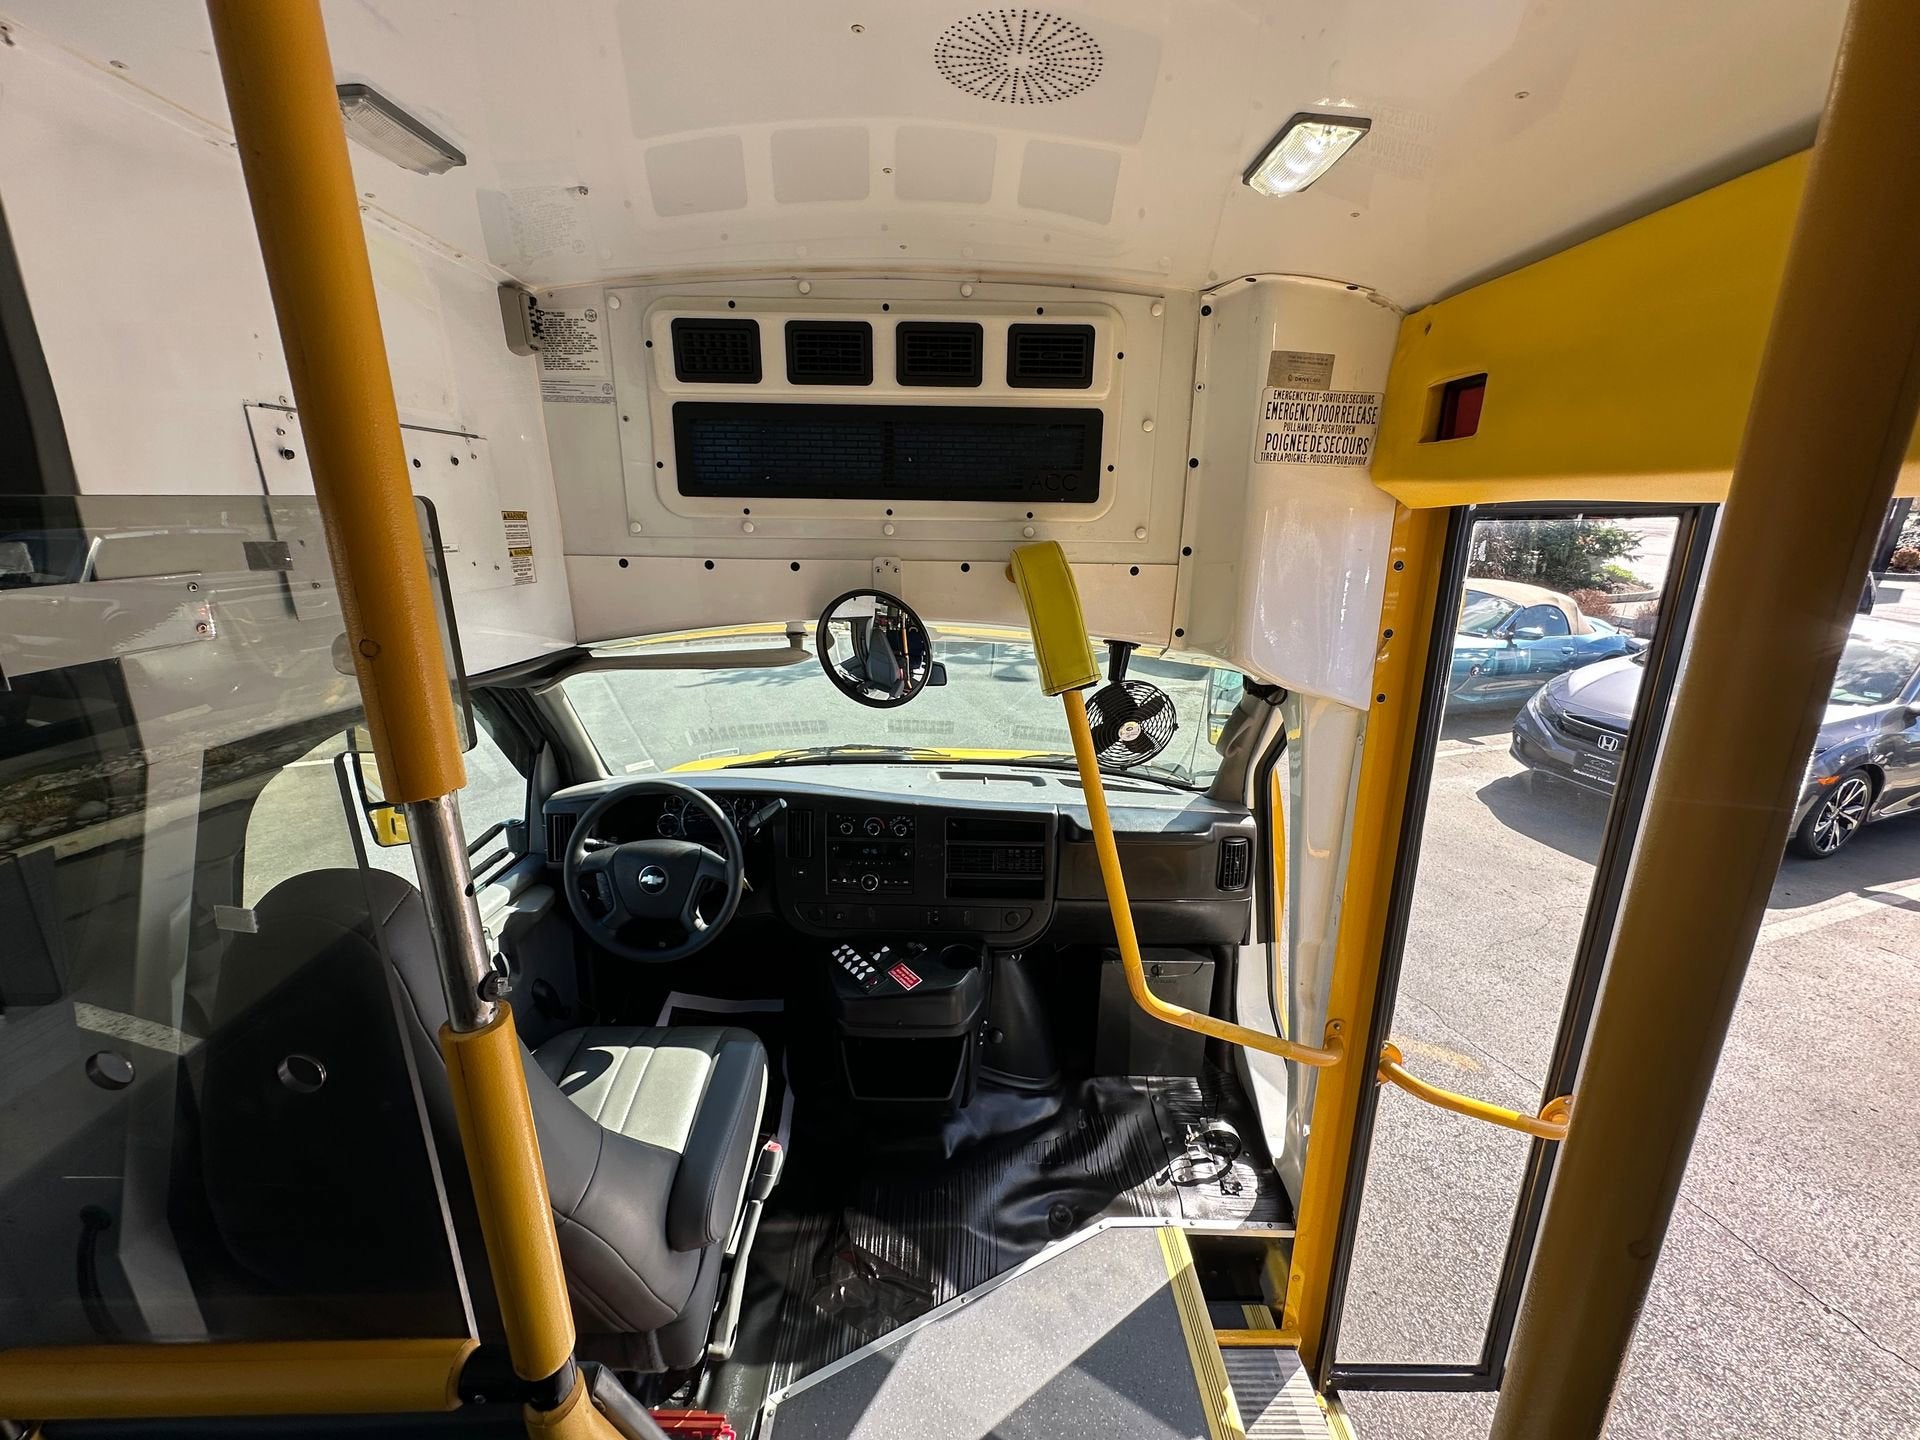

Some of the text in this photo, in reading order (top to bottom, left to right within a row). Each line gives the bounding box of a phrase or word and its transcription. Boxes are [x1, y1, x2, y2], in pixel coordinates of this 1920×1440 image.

[1273, 390, 1307, 401] EMERGENCY
[1307, 391, 1320, 401] EXIT
[1322, 393, 1342, 403] SORTIE
[1342, 394, 1349, 403] DE
[1349, 394, 1375, 405] SECOURS
[1265, 401, 1378, 425] EMERGENCY DOOR RELEASE
[1283, 422, 1297, 432] PULL
[1297, 423, 1318, 433] HANDLE
[1320, 424, 1335, 434] PUSH
[1335, 425, 1341, 434] TO
[1341, 425, 1356, 435] OPEN
[1264, 433, 1369, 455] POIGNEE DE SECOURS
[1260, 452, 1277, 462] TIRER
[1277, 452, 1283, 462] LA
[1283, 453, 1307, 463] POIGNEE
[1309, 454, 1334, 464] POUSSER
[1334, 455, 1349, 465] POUR
[1349, 456, 1368, 466] OUVRIR
